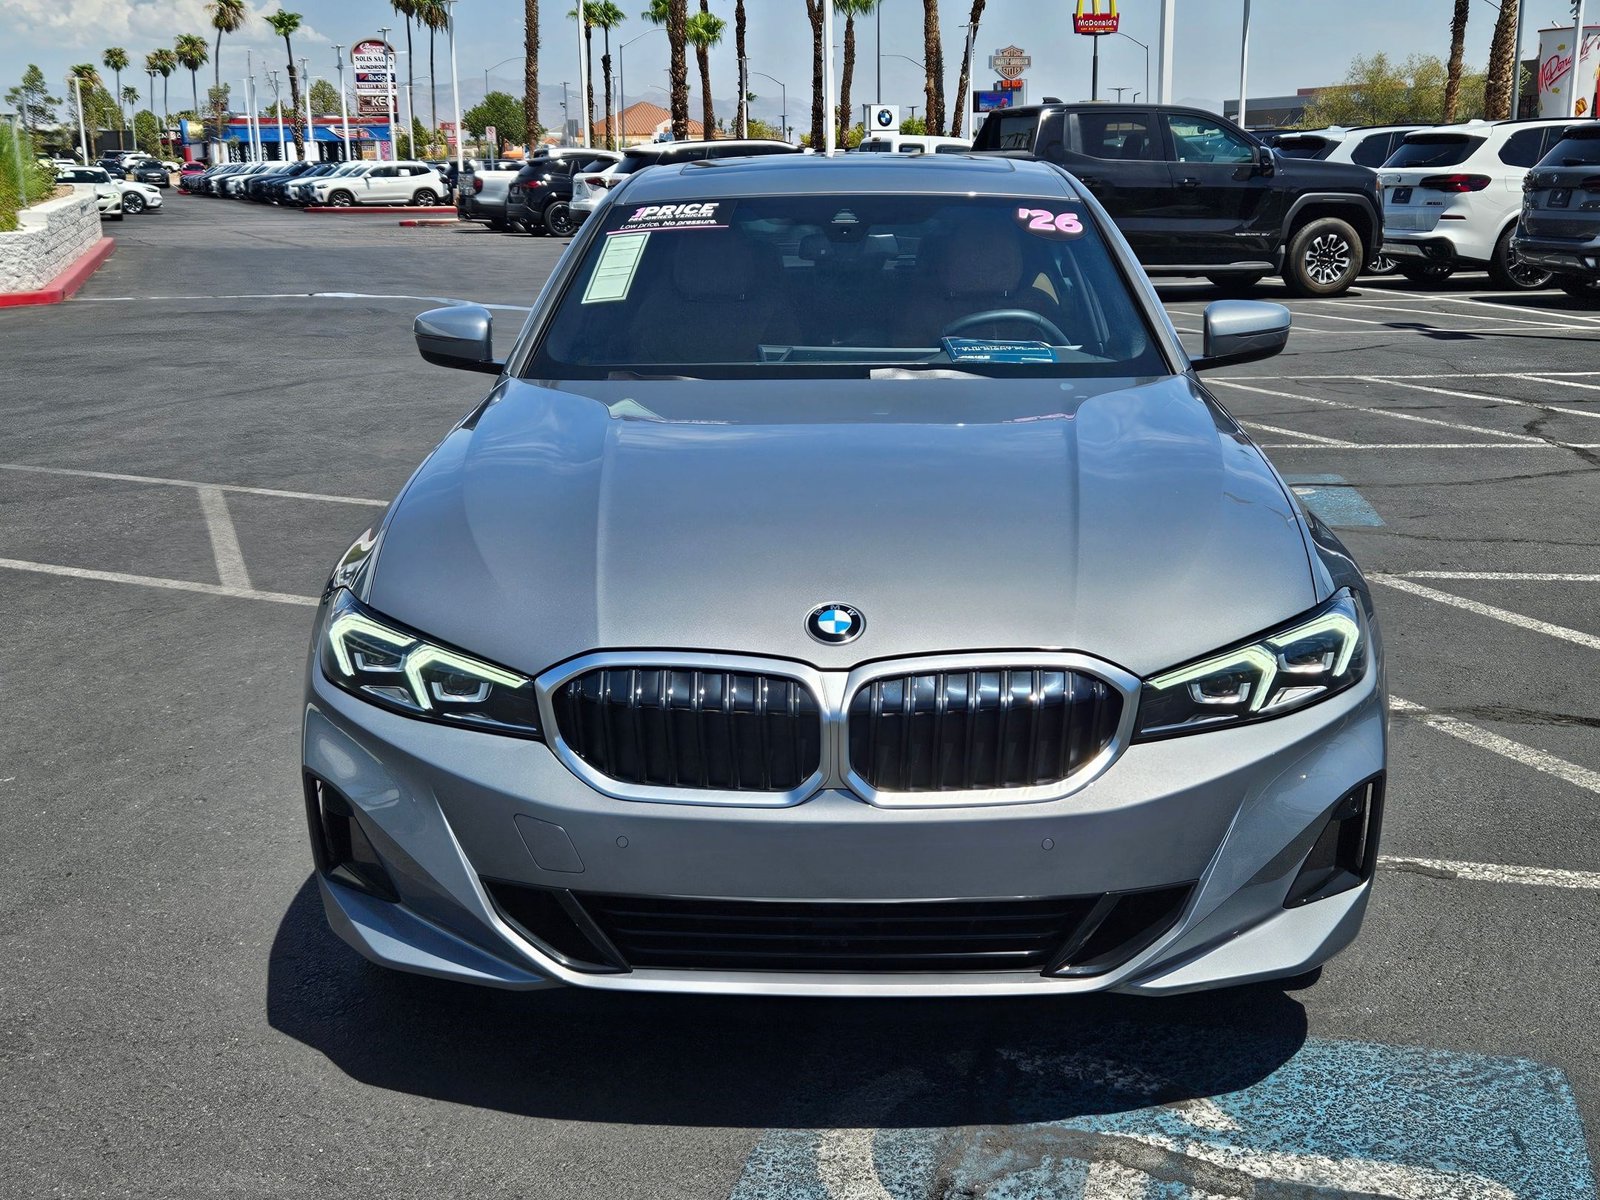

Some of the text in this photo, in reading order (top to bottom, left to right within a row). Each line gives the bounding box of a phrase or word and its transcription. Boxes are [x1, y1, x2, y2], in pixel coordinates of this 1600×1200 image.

[368, 74, 393, 82] Budgt
[631, 203, 720, 219] 1PRICE
[637, 221, 660, 230] price.
[676, 219, 717, 227] pressure.
[1018, 208, 1083, 233] '26
